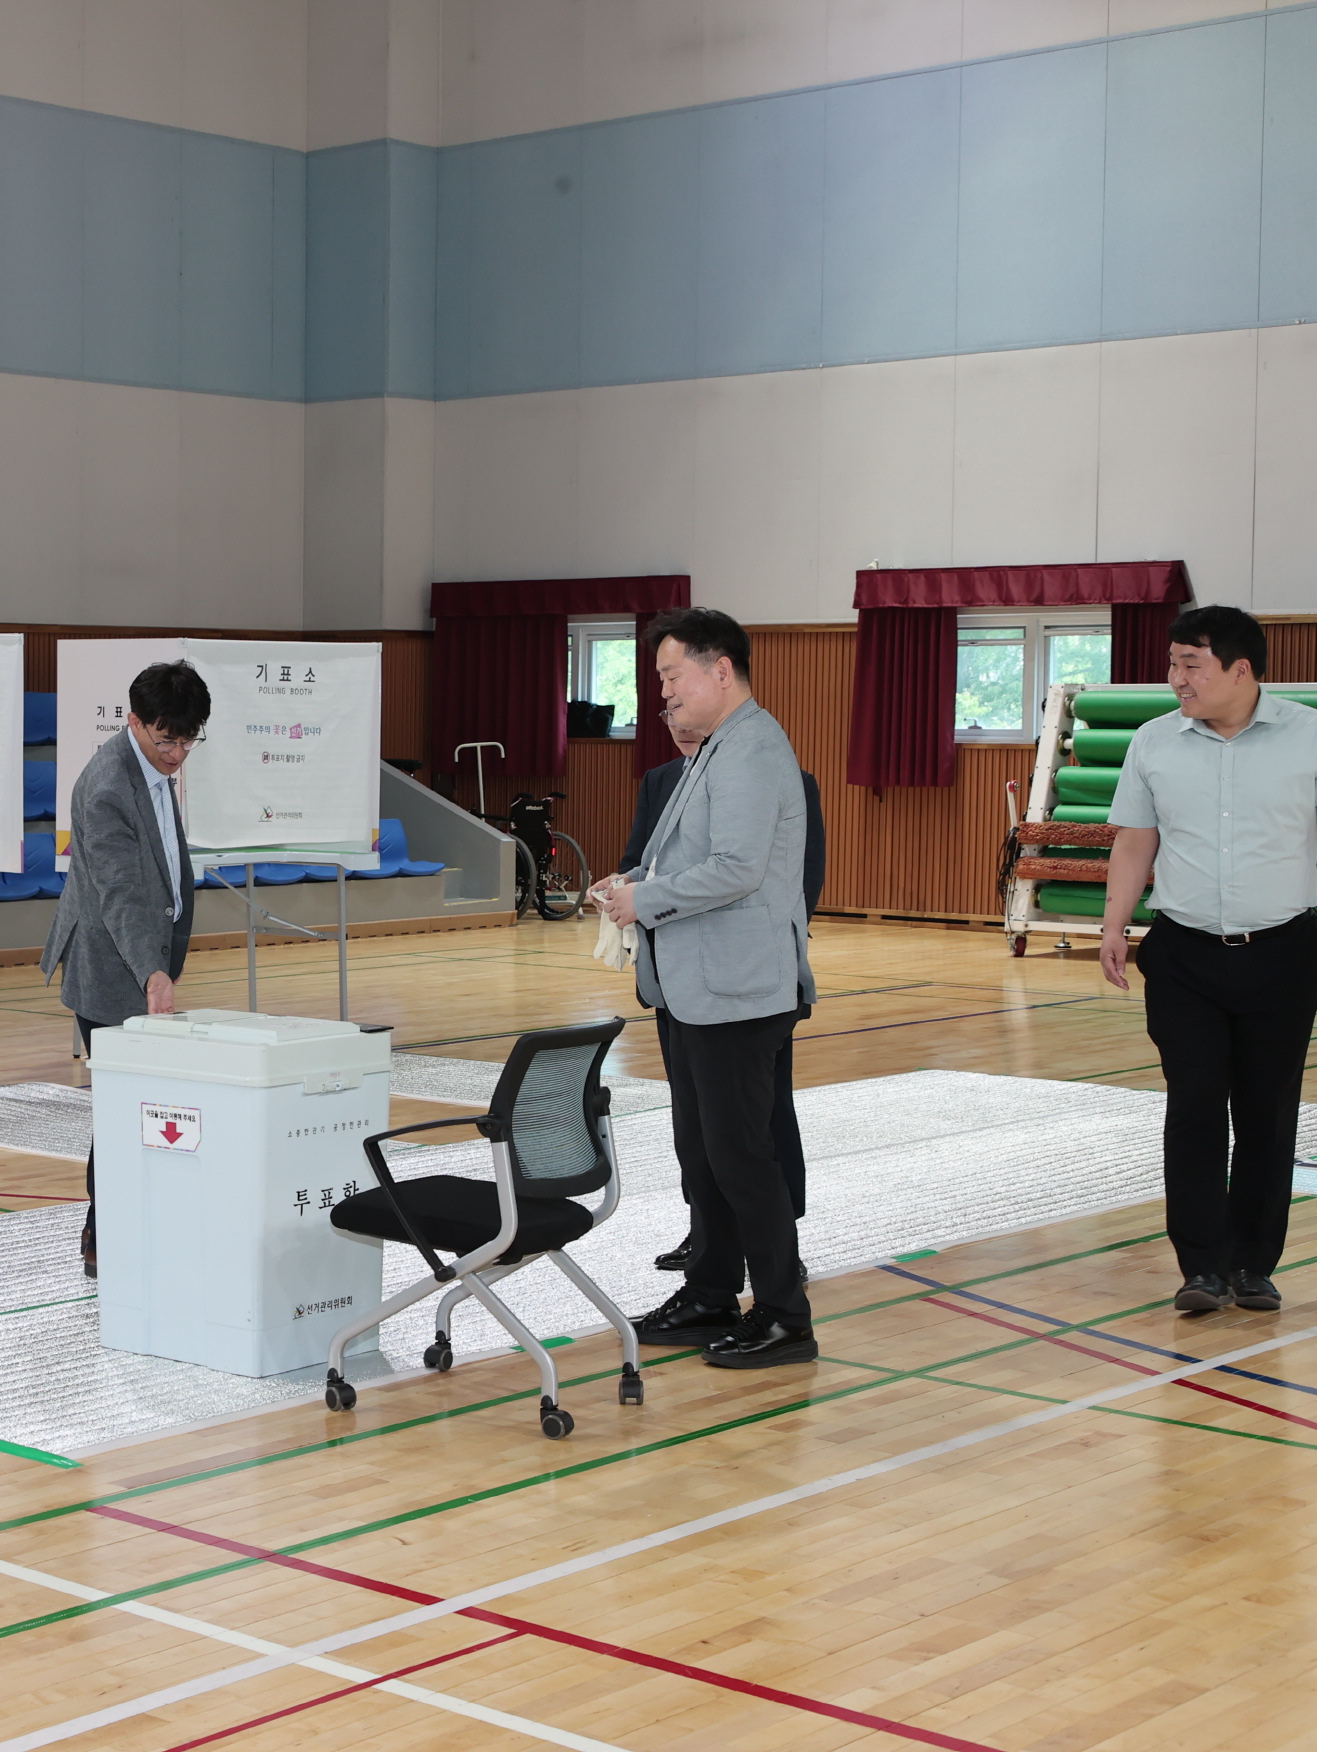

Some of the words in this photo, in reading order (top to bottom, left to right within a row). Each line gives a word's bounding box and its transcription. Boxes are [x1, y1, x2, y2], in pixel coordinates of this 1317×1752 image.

[255, 663, 316, 683] 기표소
[258, 686, 286, 695] POLLING
[290, 687, 313, 696] BOOTH
[97, 706, 123, 718] 기표
[96, 724, 120, 732] POLLING
[246, 725, 271, 734] 민주주의
[273, 725, 287, 735] 꽃은
[306, 1295, 353, 1315] 선거관리위원회
